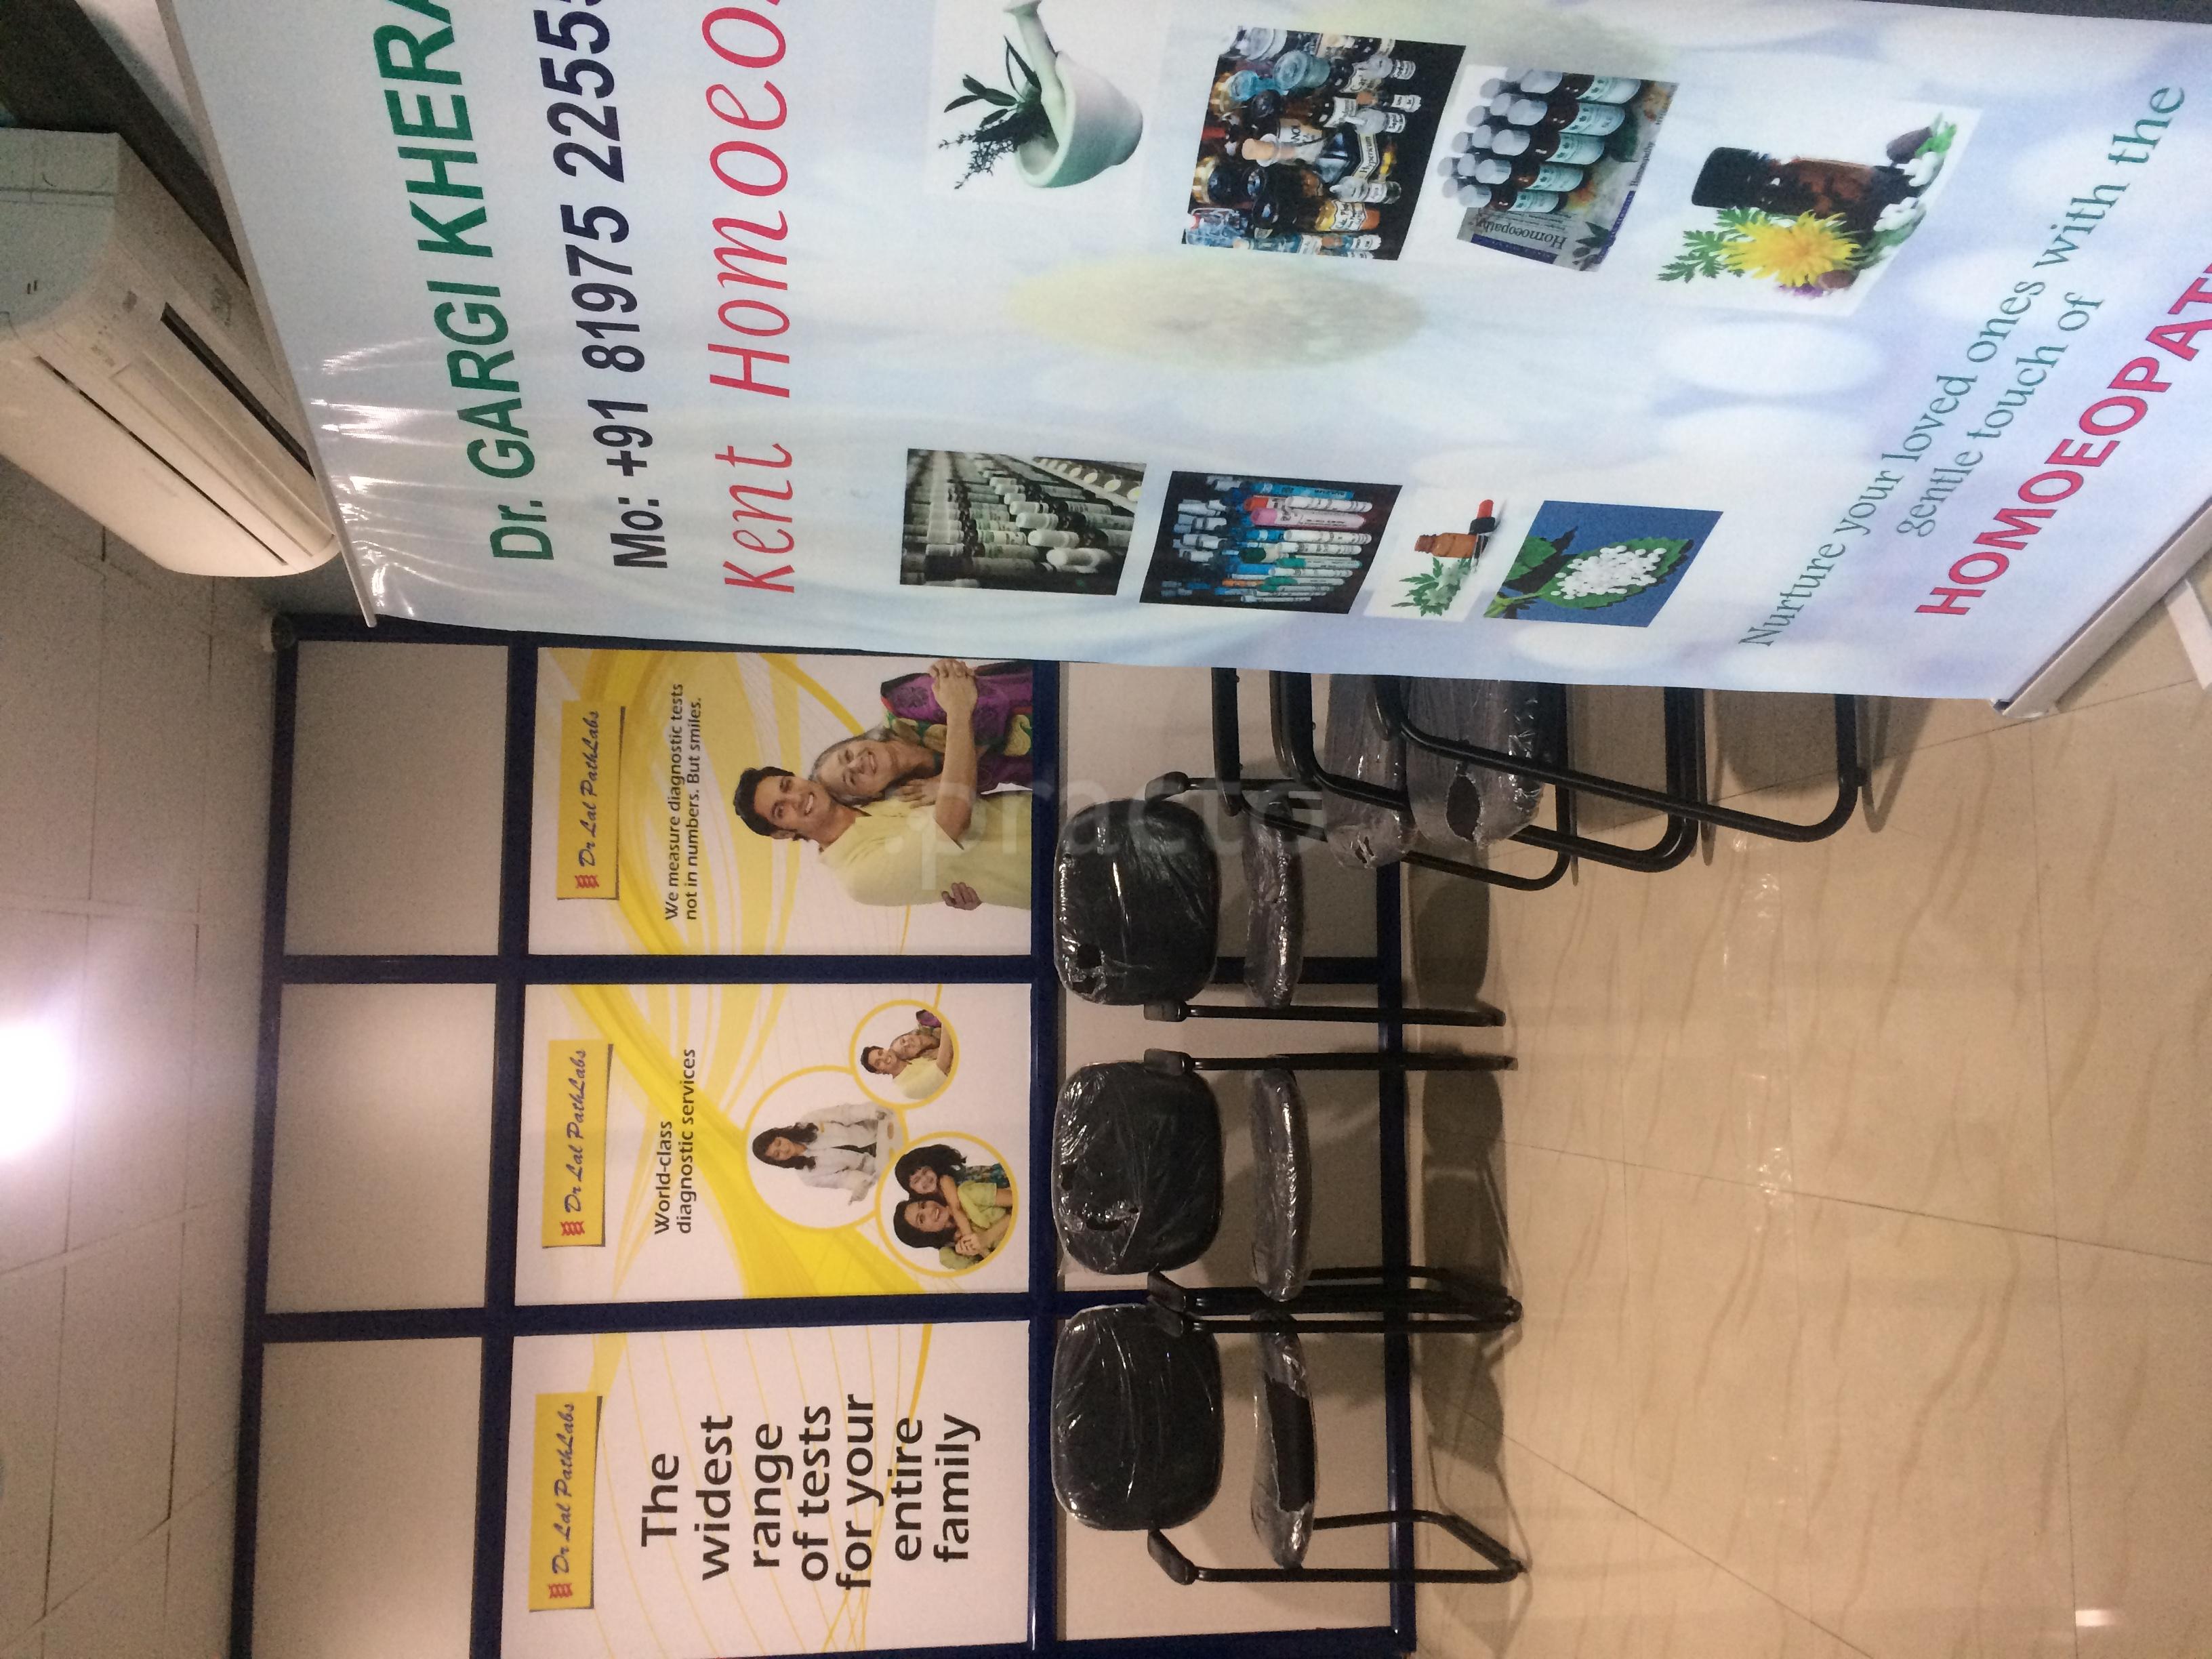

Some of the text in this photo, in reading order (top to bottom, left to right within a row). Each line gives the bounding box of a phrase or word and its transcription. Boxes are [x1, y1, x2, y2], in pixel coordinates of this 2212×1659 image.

[533, 0, 668, 568] Mo: +91 81975 2255
[702, 0, 794, 593] Kent Homoeo
[1738, 87, 2185, 646] Nurture your loved ones with the
[426, 281, 535, 478] GARGI
[1896, 292, 2105, 537] gentle touch of
[1914, 262, 2212, 615] HOMOEOPAT
[490, 501, 554, 560] Dr.
[579, 711, 598, 867] Dr Lal PathLabs
[665, 684, 685, 920] We measure diagnostic tests
[684, 698, 701, 920] not in numbers. But smiles.
[565, 1050, 586, 1212] Dr Lal PathLabs
[655, 1122, 672, 1234] World-class
[676, 1050, 697, 1233] diagnostic services
[552, 1404, 574, 1574] Dr Lal PathLabs
[641, 1454, 679, 1547] The
[695, 1416, 733, 1580] widest
[754, 1424, 793, 1567] range
[793, 1406, 830, 1581] of tests
[836, 1394, 884, 1590] for your
[888, 1418, 922, 1561] entire
[933, 1413, 981, 1562] family
